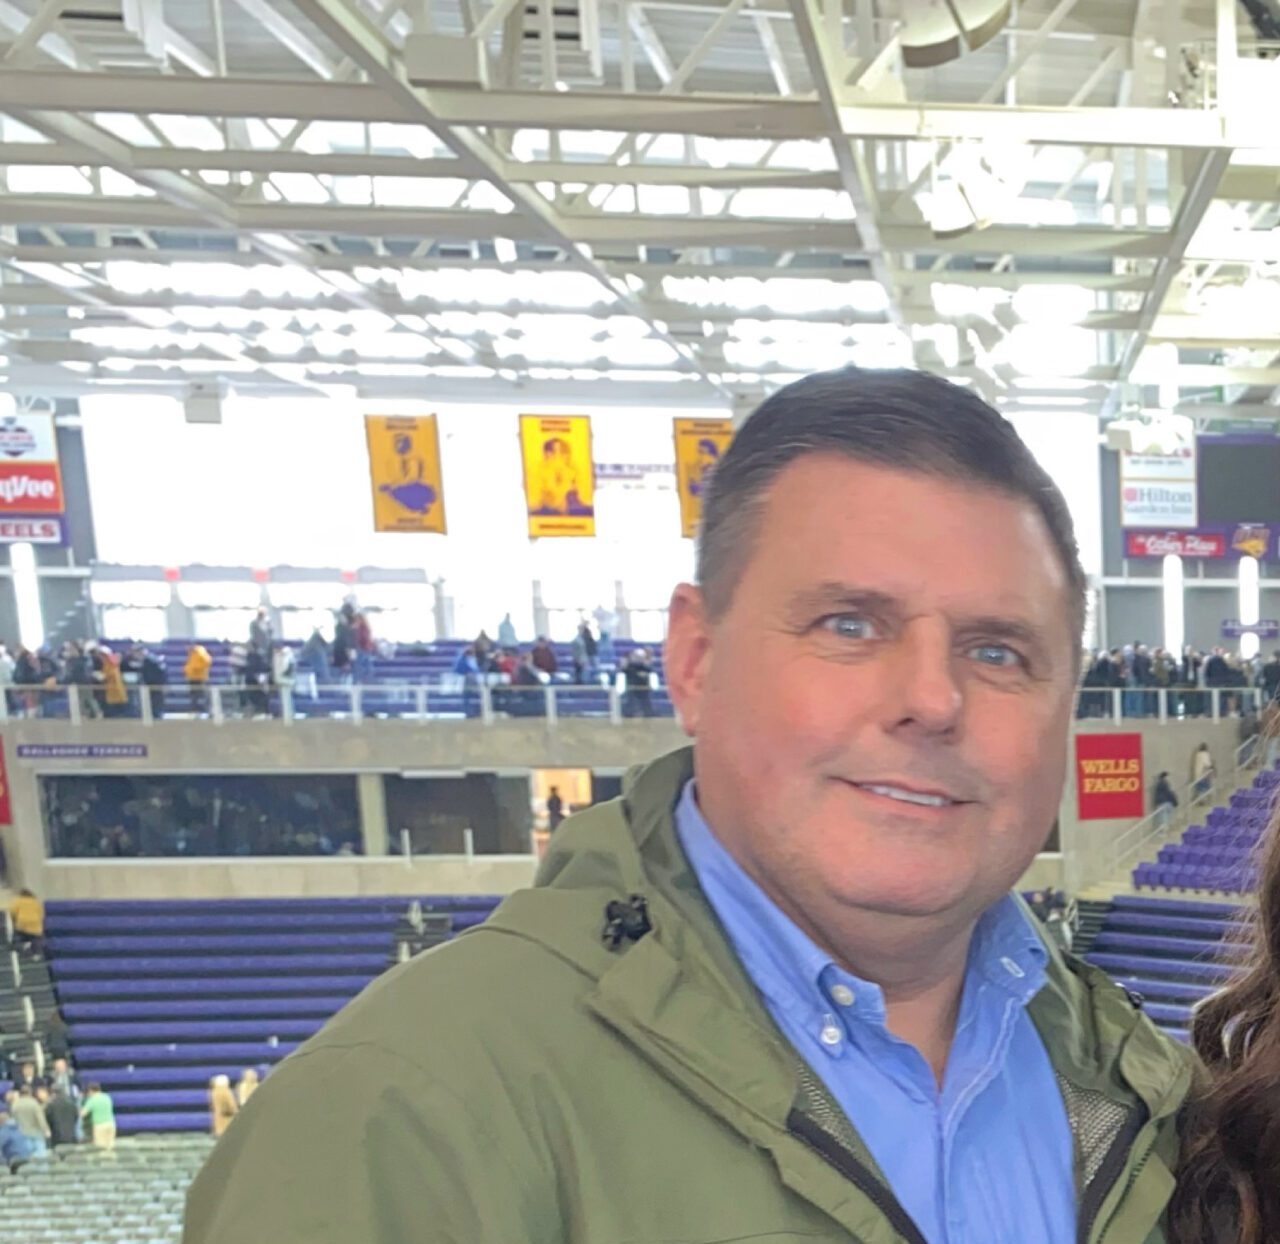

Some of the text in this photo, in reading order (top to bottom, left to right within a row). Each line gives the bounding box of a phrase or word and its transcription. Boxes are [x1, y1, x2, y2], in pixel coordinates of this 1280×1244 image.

[1139, 488, 1192, 502] Hilton
[0, 523, 55, 538] EELS
[92, 746, 143, 756] TERRACE
[1080, 758, 1140, 774] WELLS
[1083, 777, 1140, 793] FARGO
